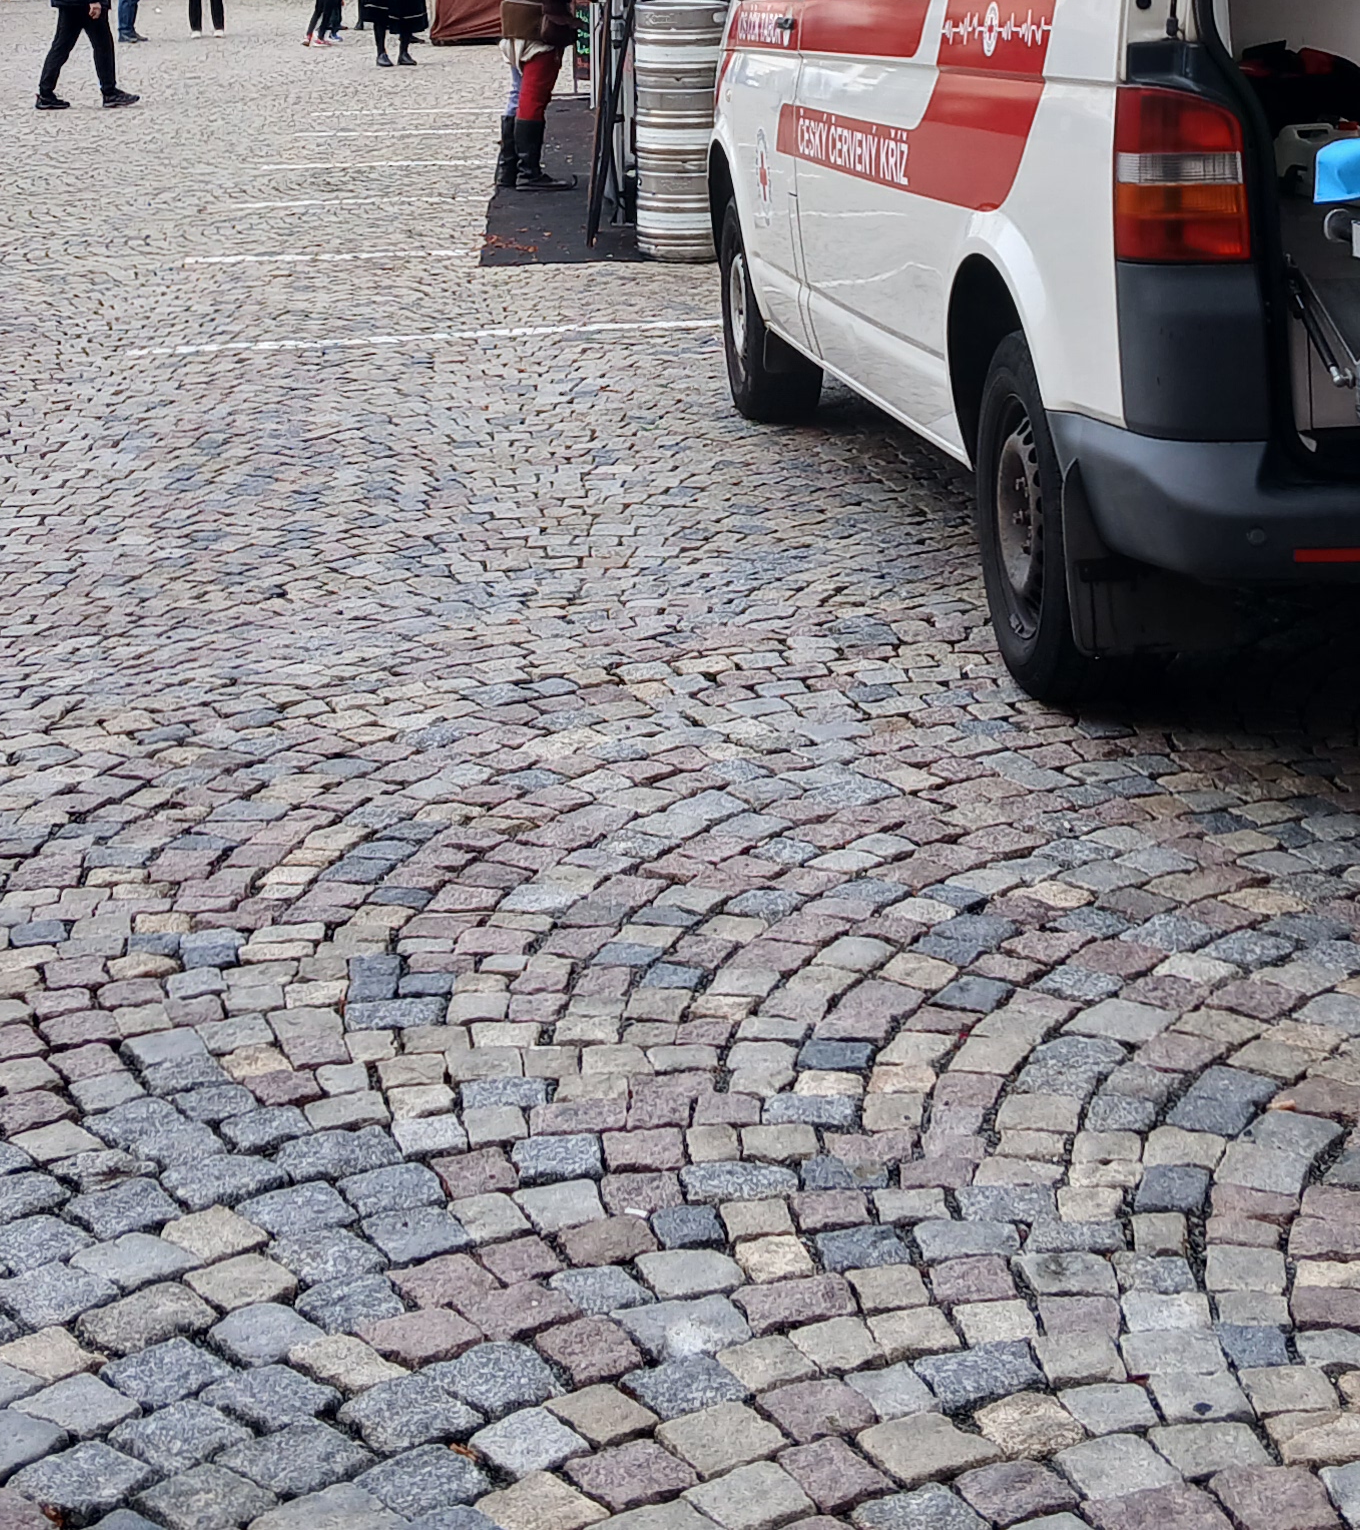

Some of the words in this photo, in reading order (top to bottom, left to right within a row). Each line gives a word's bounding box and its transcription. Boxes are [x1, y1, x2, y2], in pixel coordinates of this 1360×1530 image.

[798, 108, 829, 161] ČESKÝ
[828, 115, 878, 177] ČERVENÝ
[880, 129, 909, 186] KŘÍŽ
